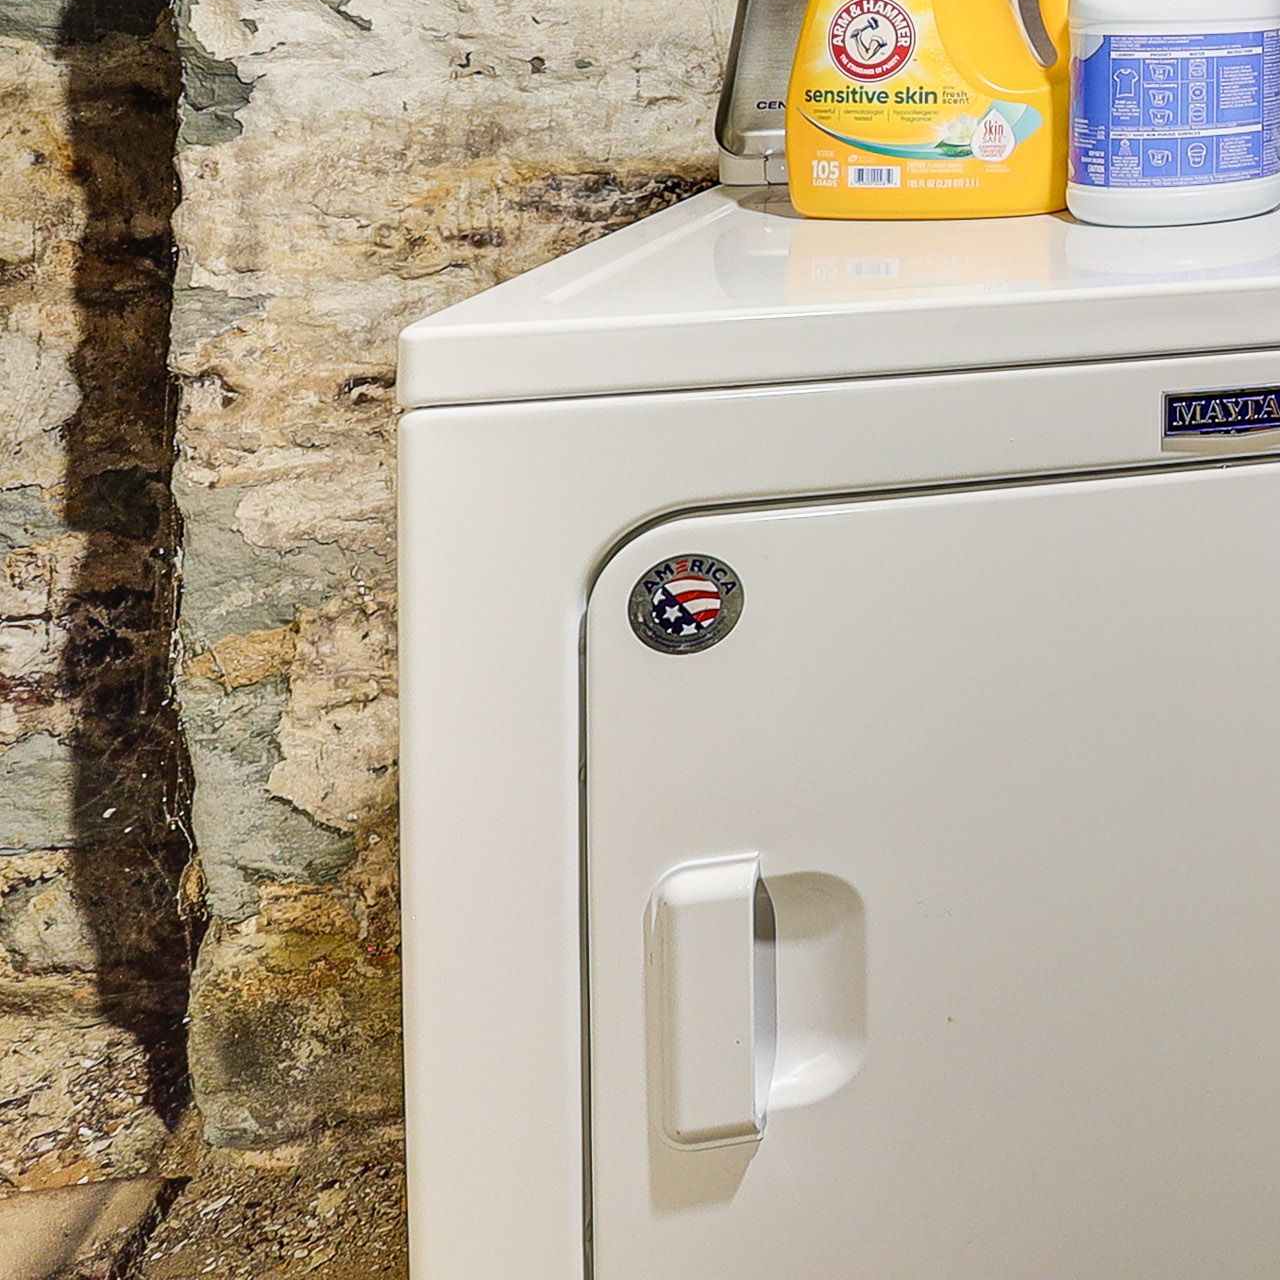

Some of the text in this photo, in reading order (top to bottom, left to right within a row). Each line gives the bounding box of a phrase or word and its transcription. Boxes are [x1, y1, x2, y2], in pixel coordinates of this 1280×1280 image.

[832, 11, 851, 46] ARM
[862, 0, 912, 47] HAMMER
[804, 85, 938, 105] sensitive skin
[942, 96, 970, 105] scent
[984, 120, 1004, 136] Skin
[811, 160, 840, 179] 105
[812, 178, 838, 187] LOADS
[643, 558, 737, 595] AMERICA
